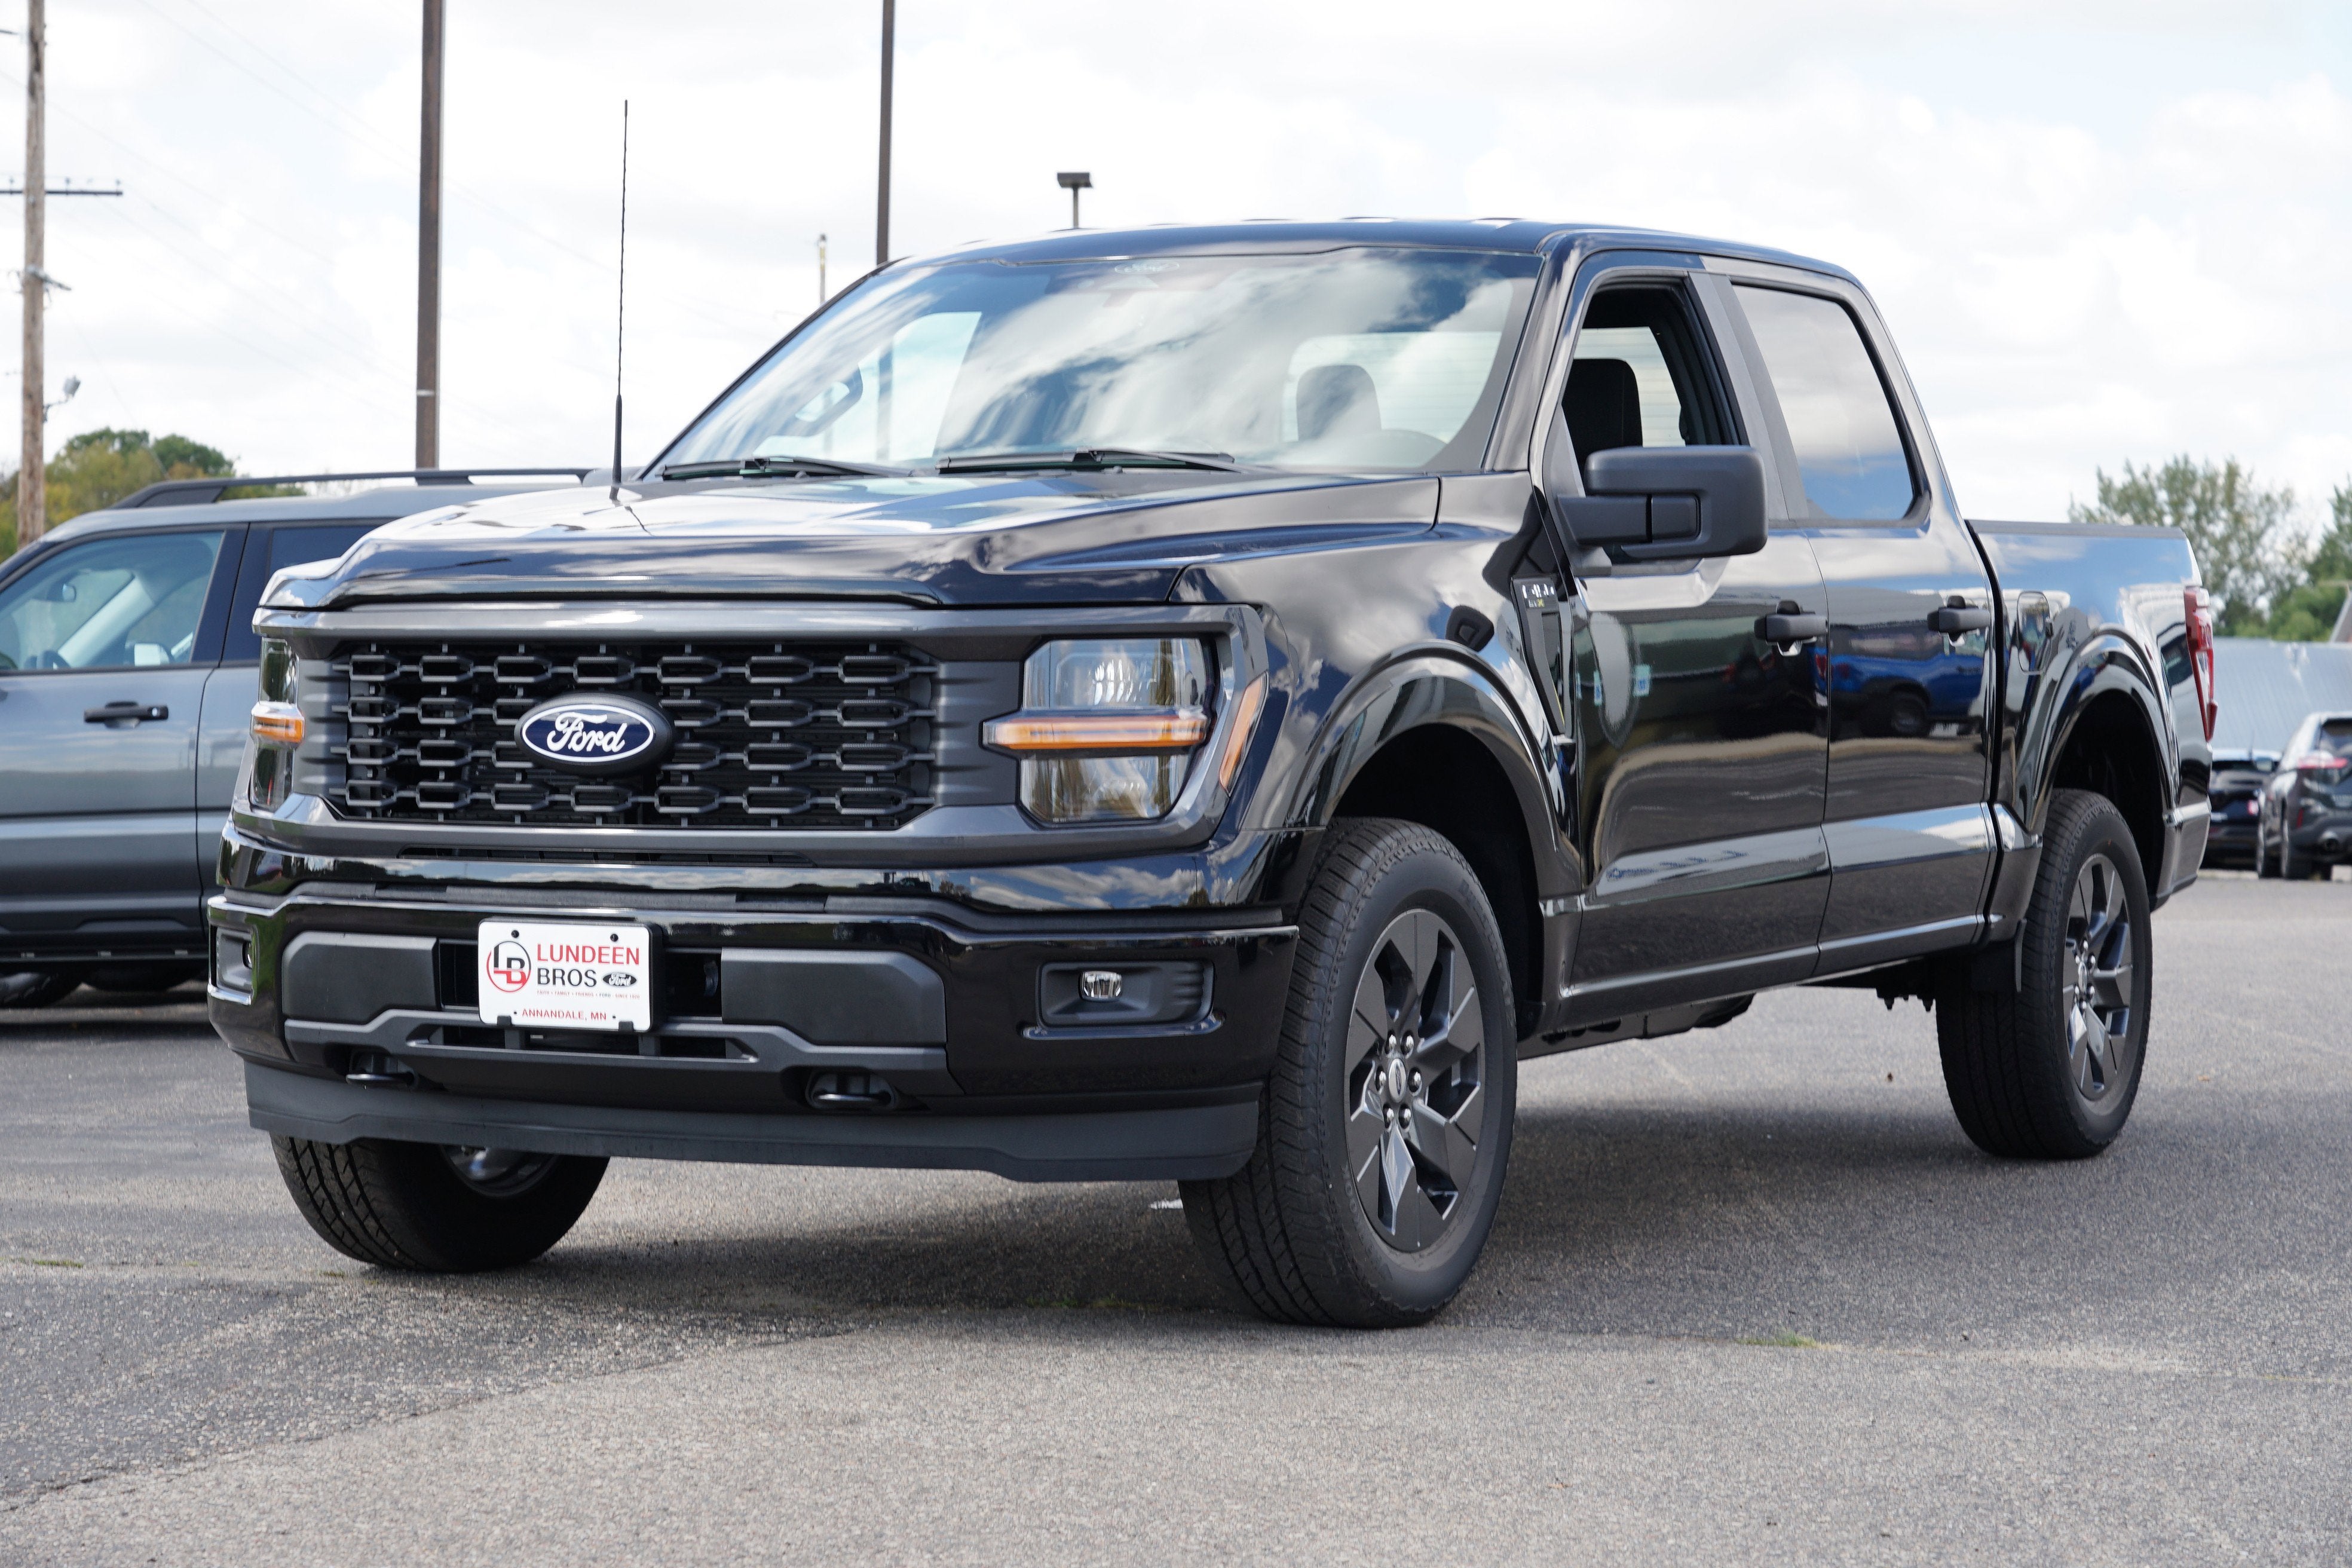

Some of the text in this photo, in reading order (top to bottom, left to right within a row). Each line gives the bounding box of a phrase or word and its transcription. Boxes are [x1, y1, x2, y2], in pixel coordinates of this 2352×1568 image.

[546, 711, 628, 753] Ford
[537, 944, 640, 966] LUNDEEN
[537, 967, 598, 988] BROS
[607, 972, 633, 987] Ford
[522, 1008, 607, 1021] ANNANDALE, MN
